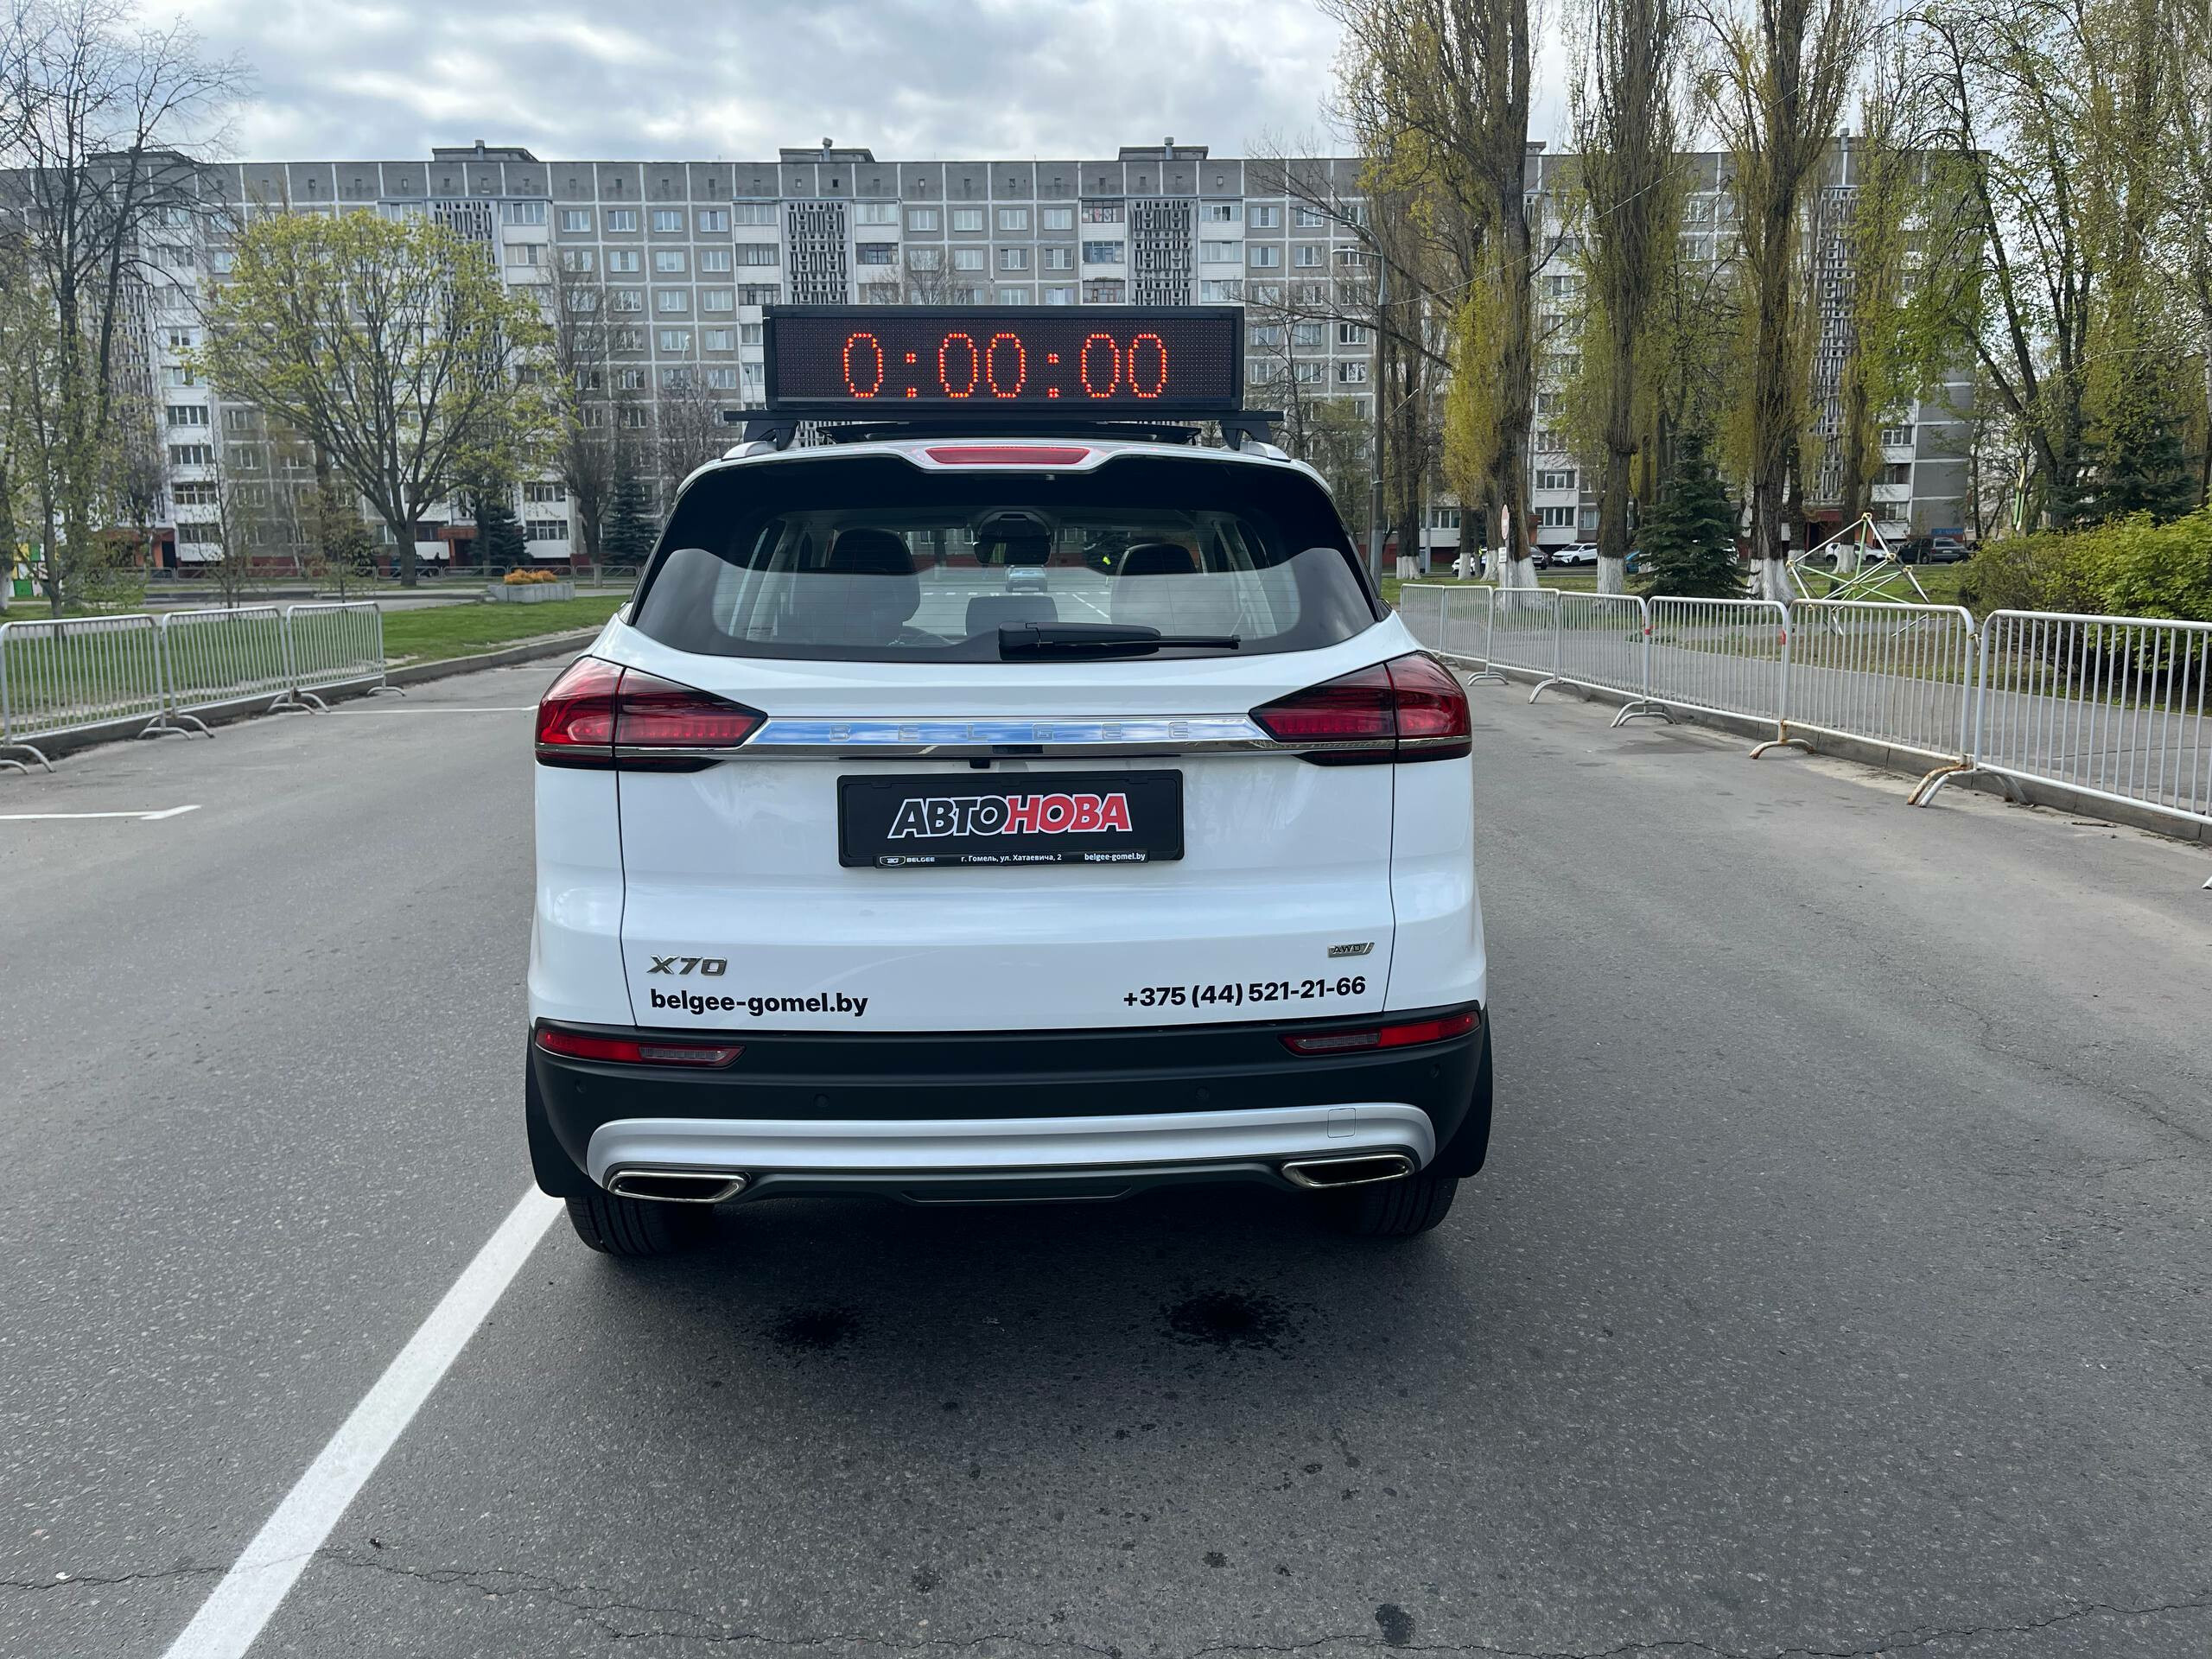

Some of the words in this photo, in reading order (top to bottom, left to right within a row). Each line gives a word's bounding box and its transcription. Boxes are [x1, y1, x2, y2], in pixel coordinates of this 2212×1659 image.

[843, 332, 1168, 398] 0:00:00
[829, 722, 1190, 741] BELGEE
[887, 793, 1133, 839] АВТОНОВА
[1084, 853, 1146, 861] belgee-gomel.by
[646, 954, 728, 976] X70
[651, 988, 868, 1017] belgee-gomel.by
[1123, 987, 1186, 1007] +375
[1192, 982, 1243, 1008] (44)
[1249, 976, 1366, 1001] 521-21-66
